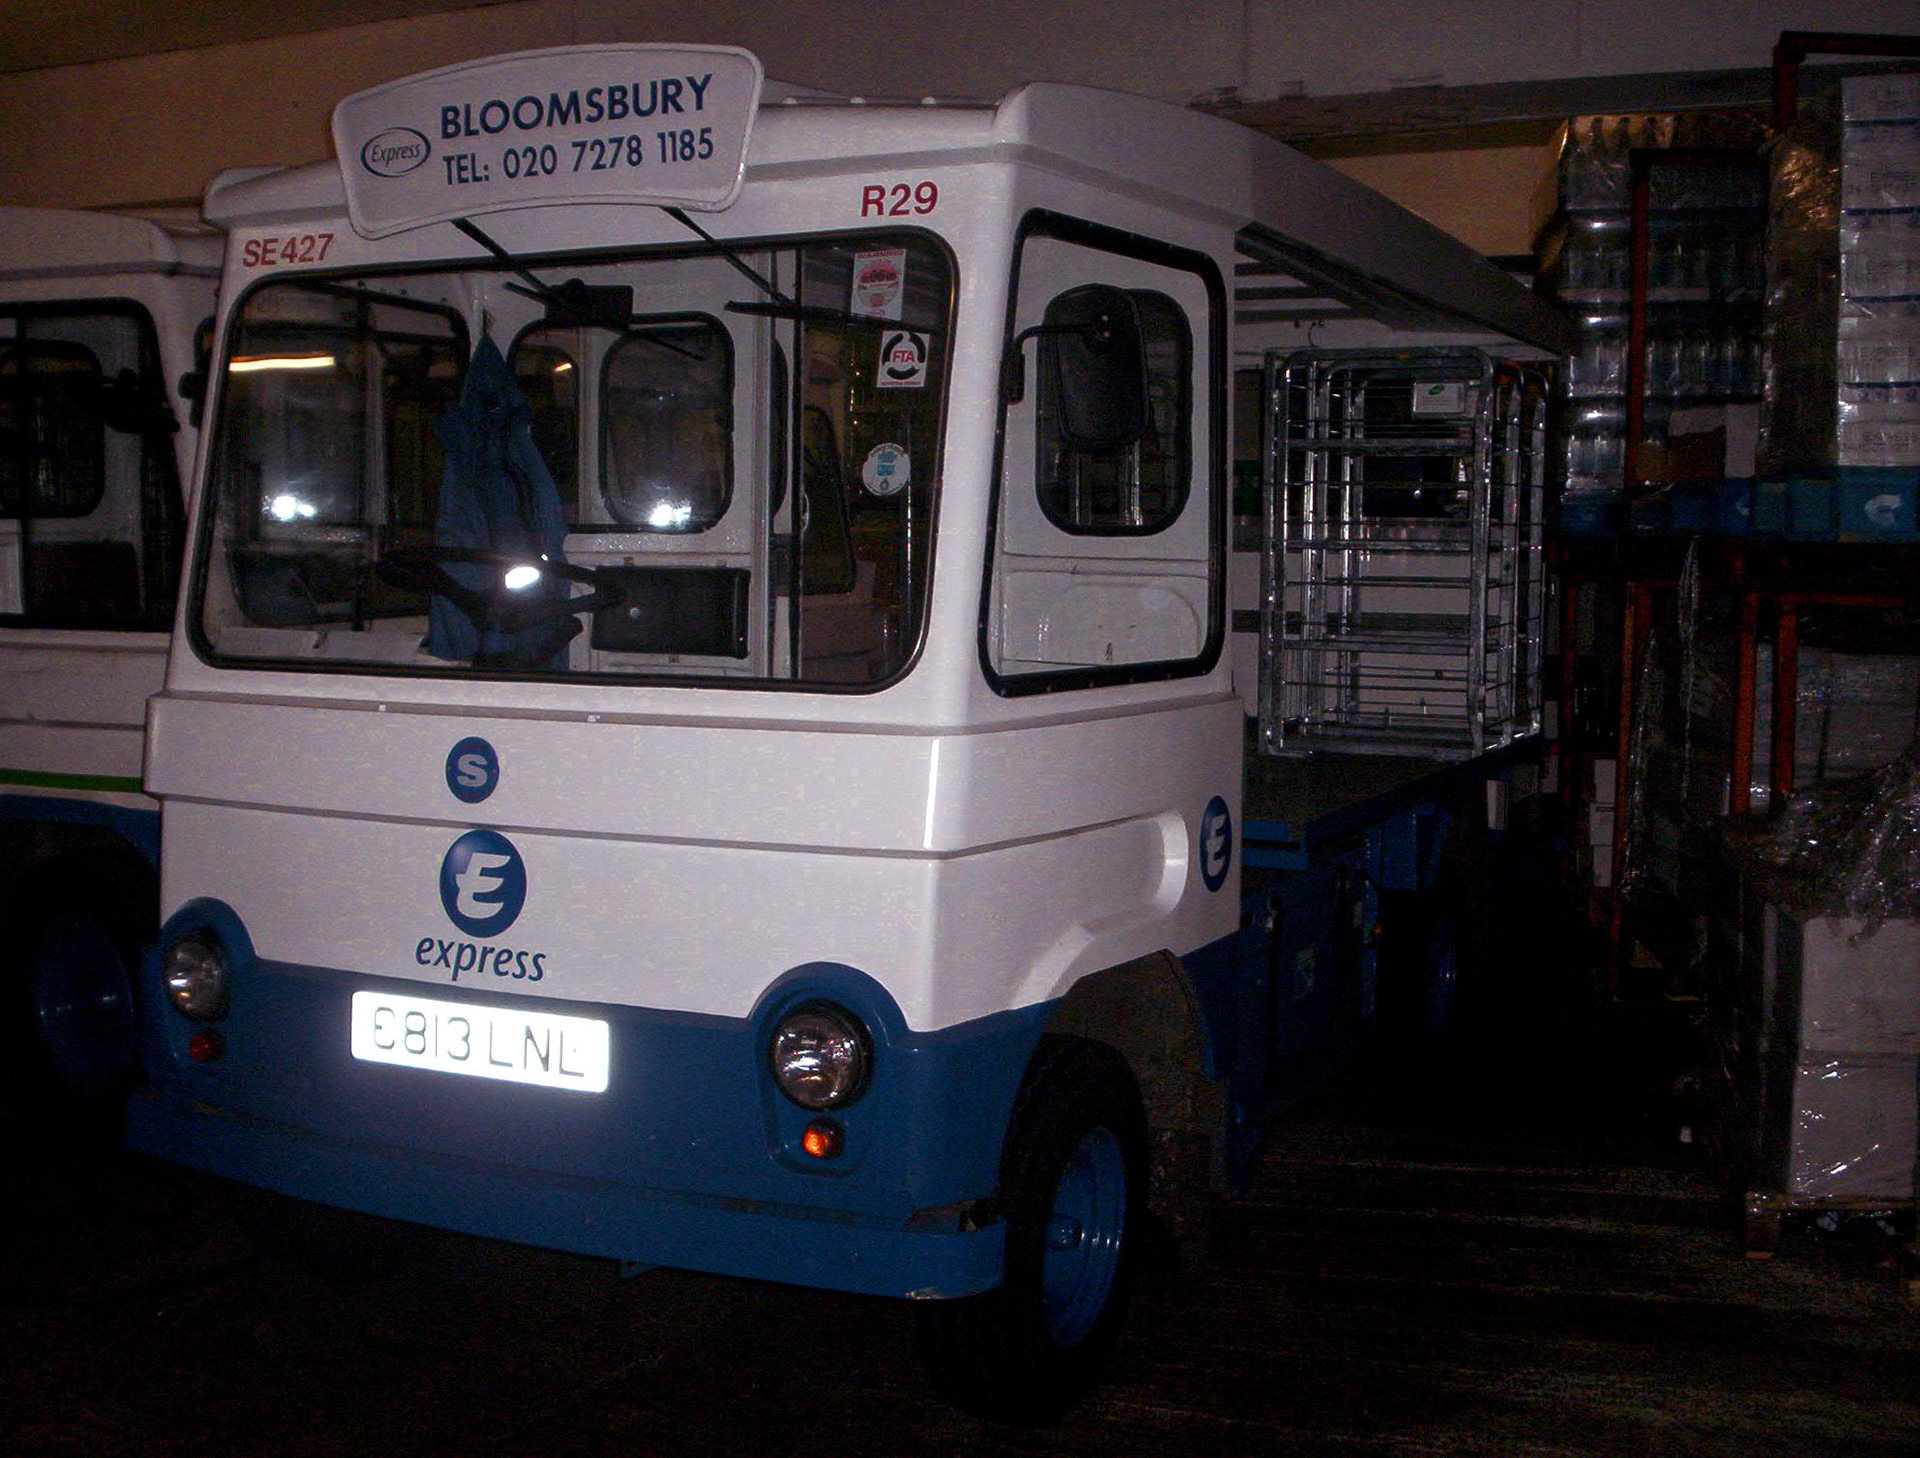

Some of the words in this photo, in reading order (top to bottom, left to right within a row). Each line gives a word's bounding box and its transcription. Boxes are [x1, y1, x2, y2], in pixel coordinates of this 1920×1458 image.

[441, 74, 713, 139] BLOOMSBURY
[371, 143, 420, 168] Express
[443, 153, 490, 186] TEL:
[503, 144, 558, 180] 020
[571, 135, 643, 172] 7278
[657, 127, 714, 164] 1185
[861, 181, 938, 217] R29
[242, 233, 335, 267] SE427
[893, 350, 914, 363] FTA
[457, 753, 488, 787] S
[416, 936, 546, 982] express
[489, 1020, 585, 1078] LNL
